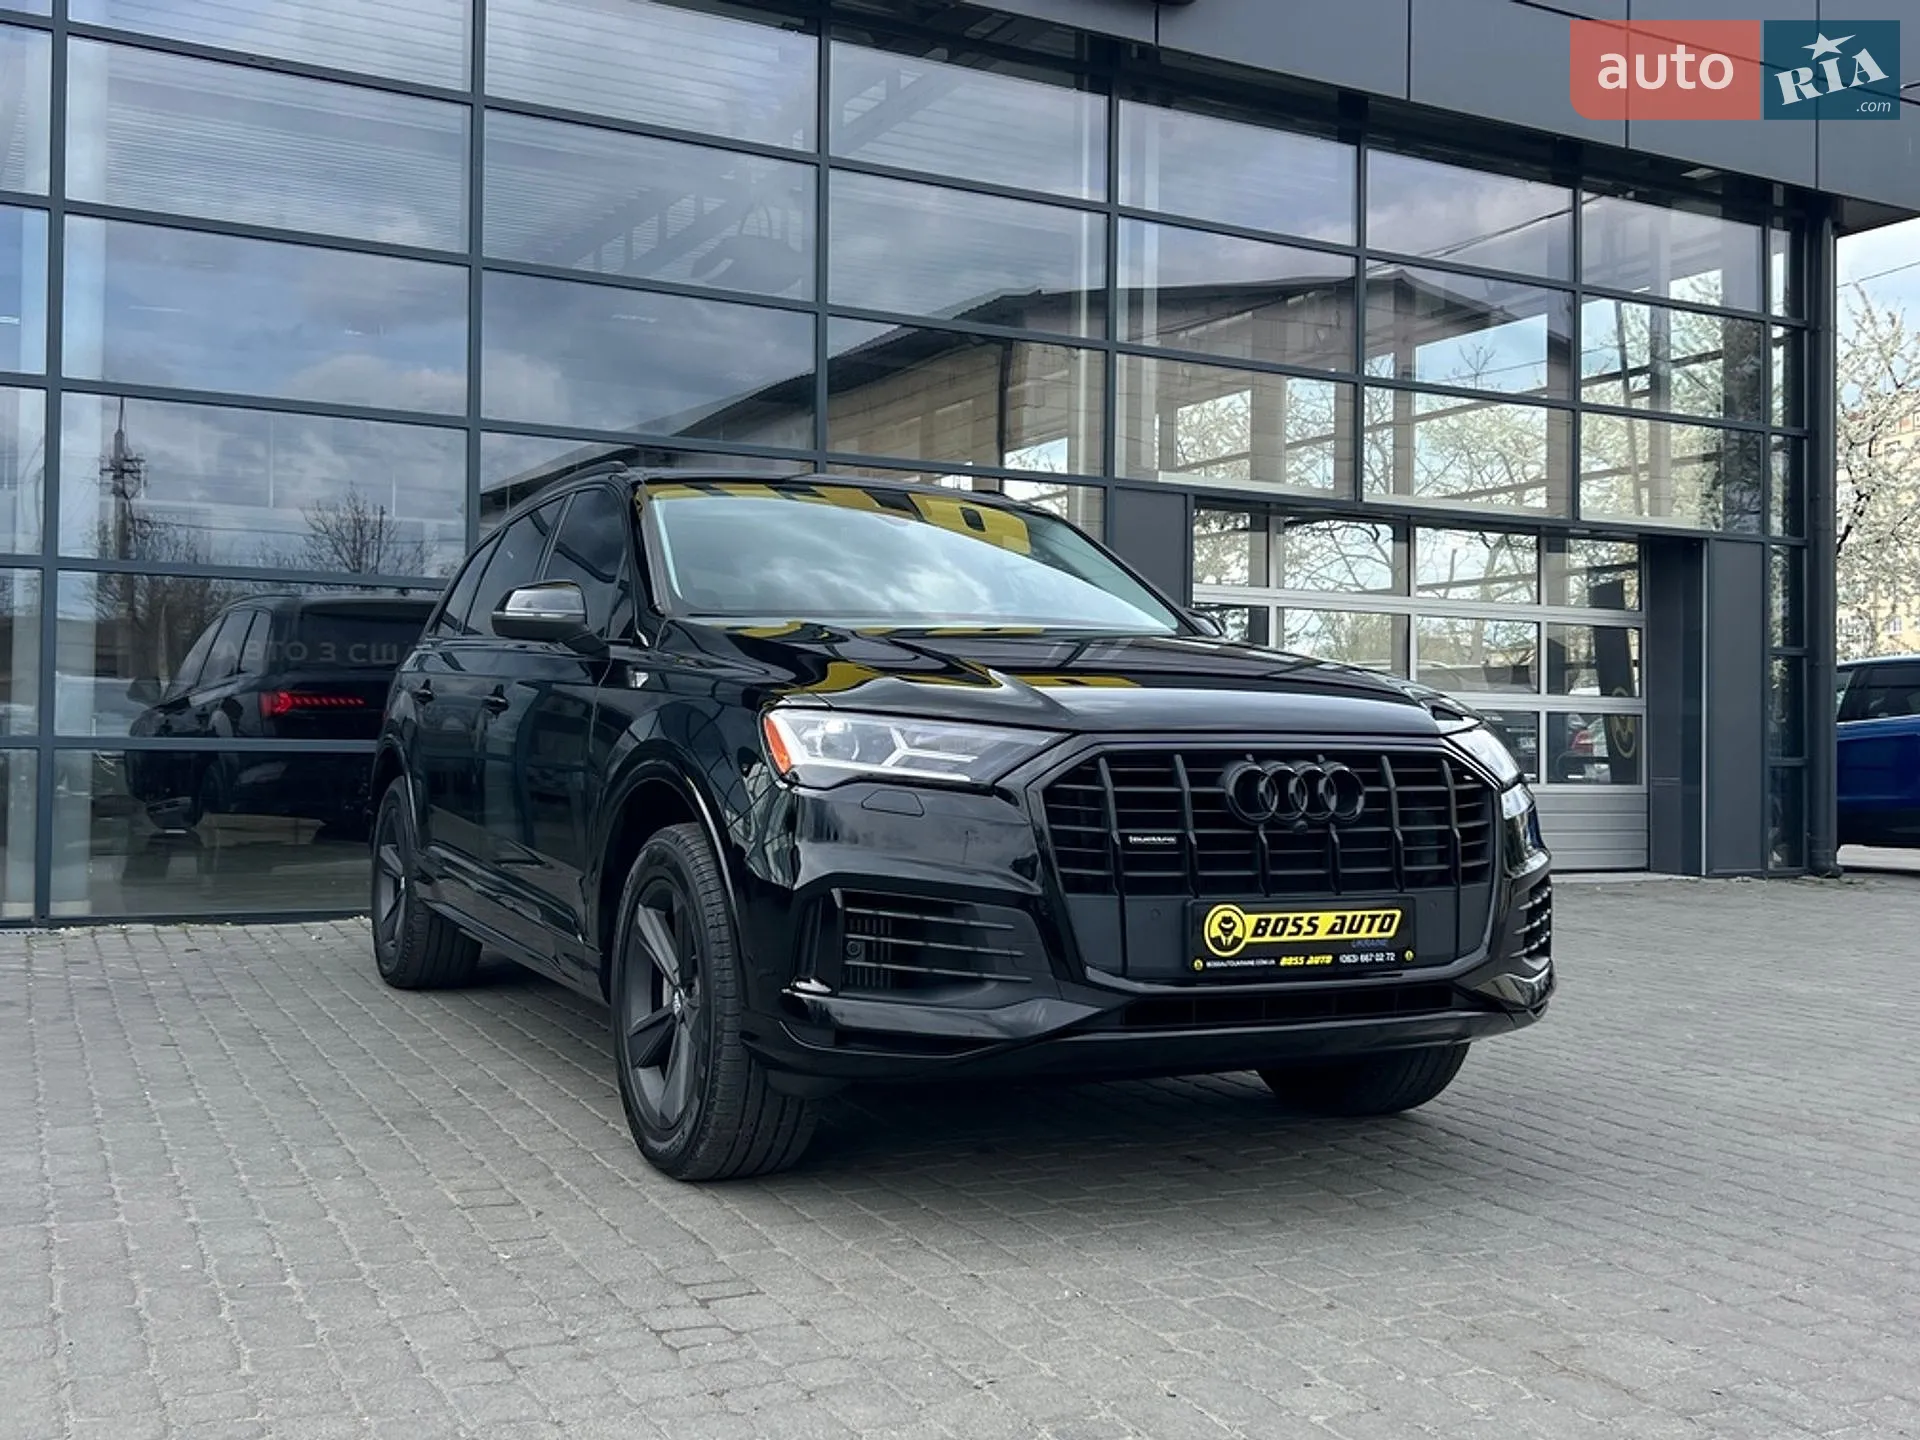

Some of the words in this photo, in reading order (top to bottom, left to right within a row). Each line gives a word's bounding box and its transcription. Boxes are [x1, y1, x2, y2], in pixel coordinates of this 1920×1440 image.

[348, 643, 406, 665] СШ
[1250, 915, 1319, 937] BOSS
[1326, 912, 1396, 935] AUTO
[1279, 956, 1305, 967] BOSS
[1306, 954, 1333, 966] AUTO
